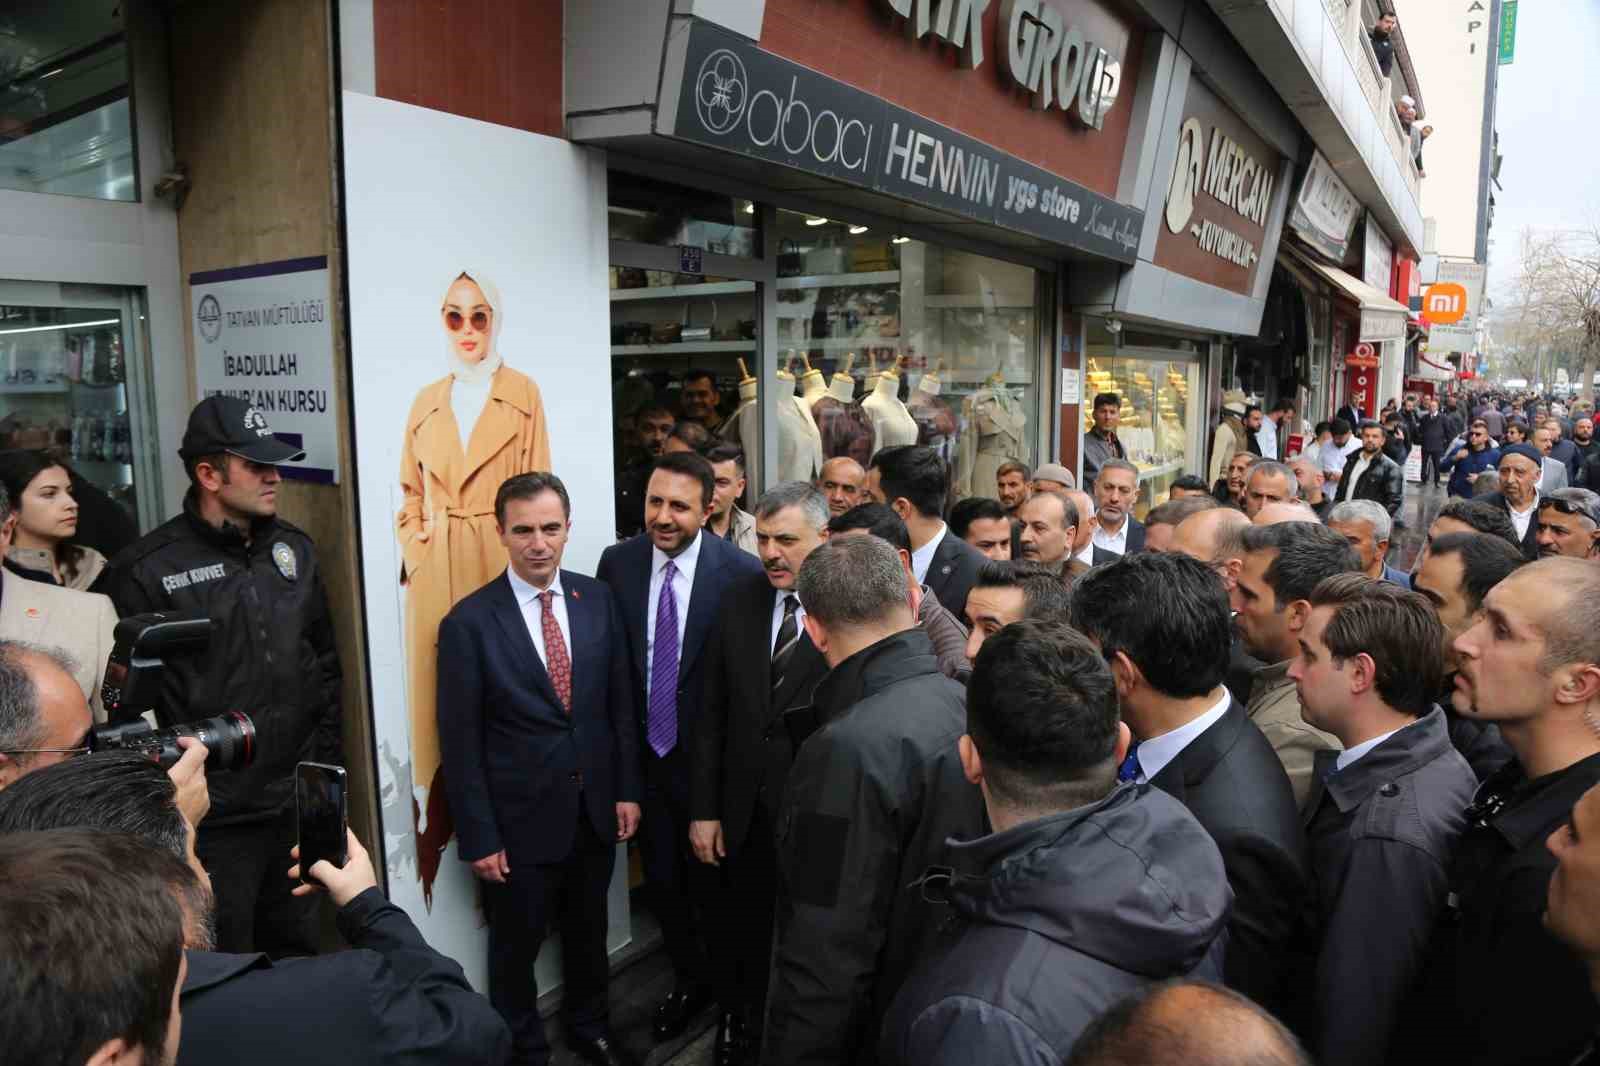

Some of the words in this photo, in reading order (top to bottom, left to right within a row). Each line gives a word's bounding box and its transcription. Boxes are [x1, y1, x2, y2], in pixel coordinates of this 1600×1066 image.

[1008, 0, 1121, 131] GROUP
[884, 122, 1000, 207] HENNIN
[1202, 127, 1273, 227] MERCAN
[1004, 175, 1039, 214] ygs
[1040, 185, 1080, 224] store
[226, 309, 260, 329] TATVAN
[223, 349, 297, 376] İBADULLAH
[278, 389, 327, 413] KURSU
